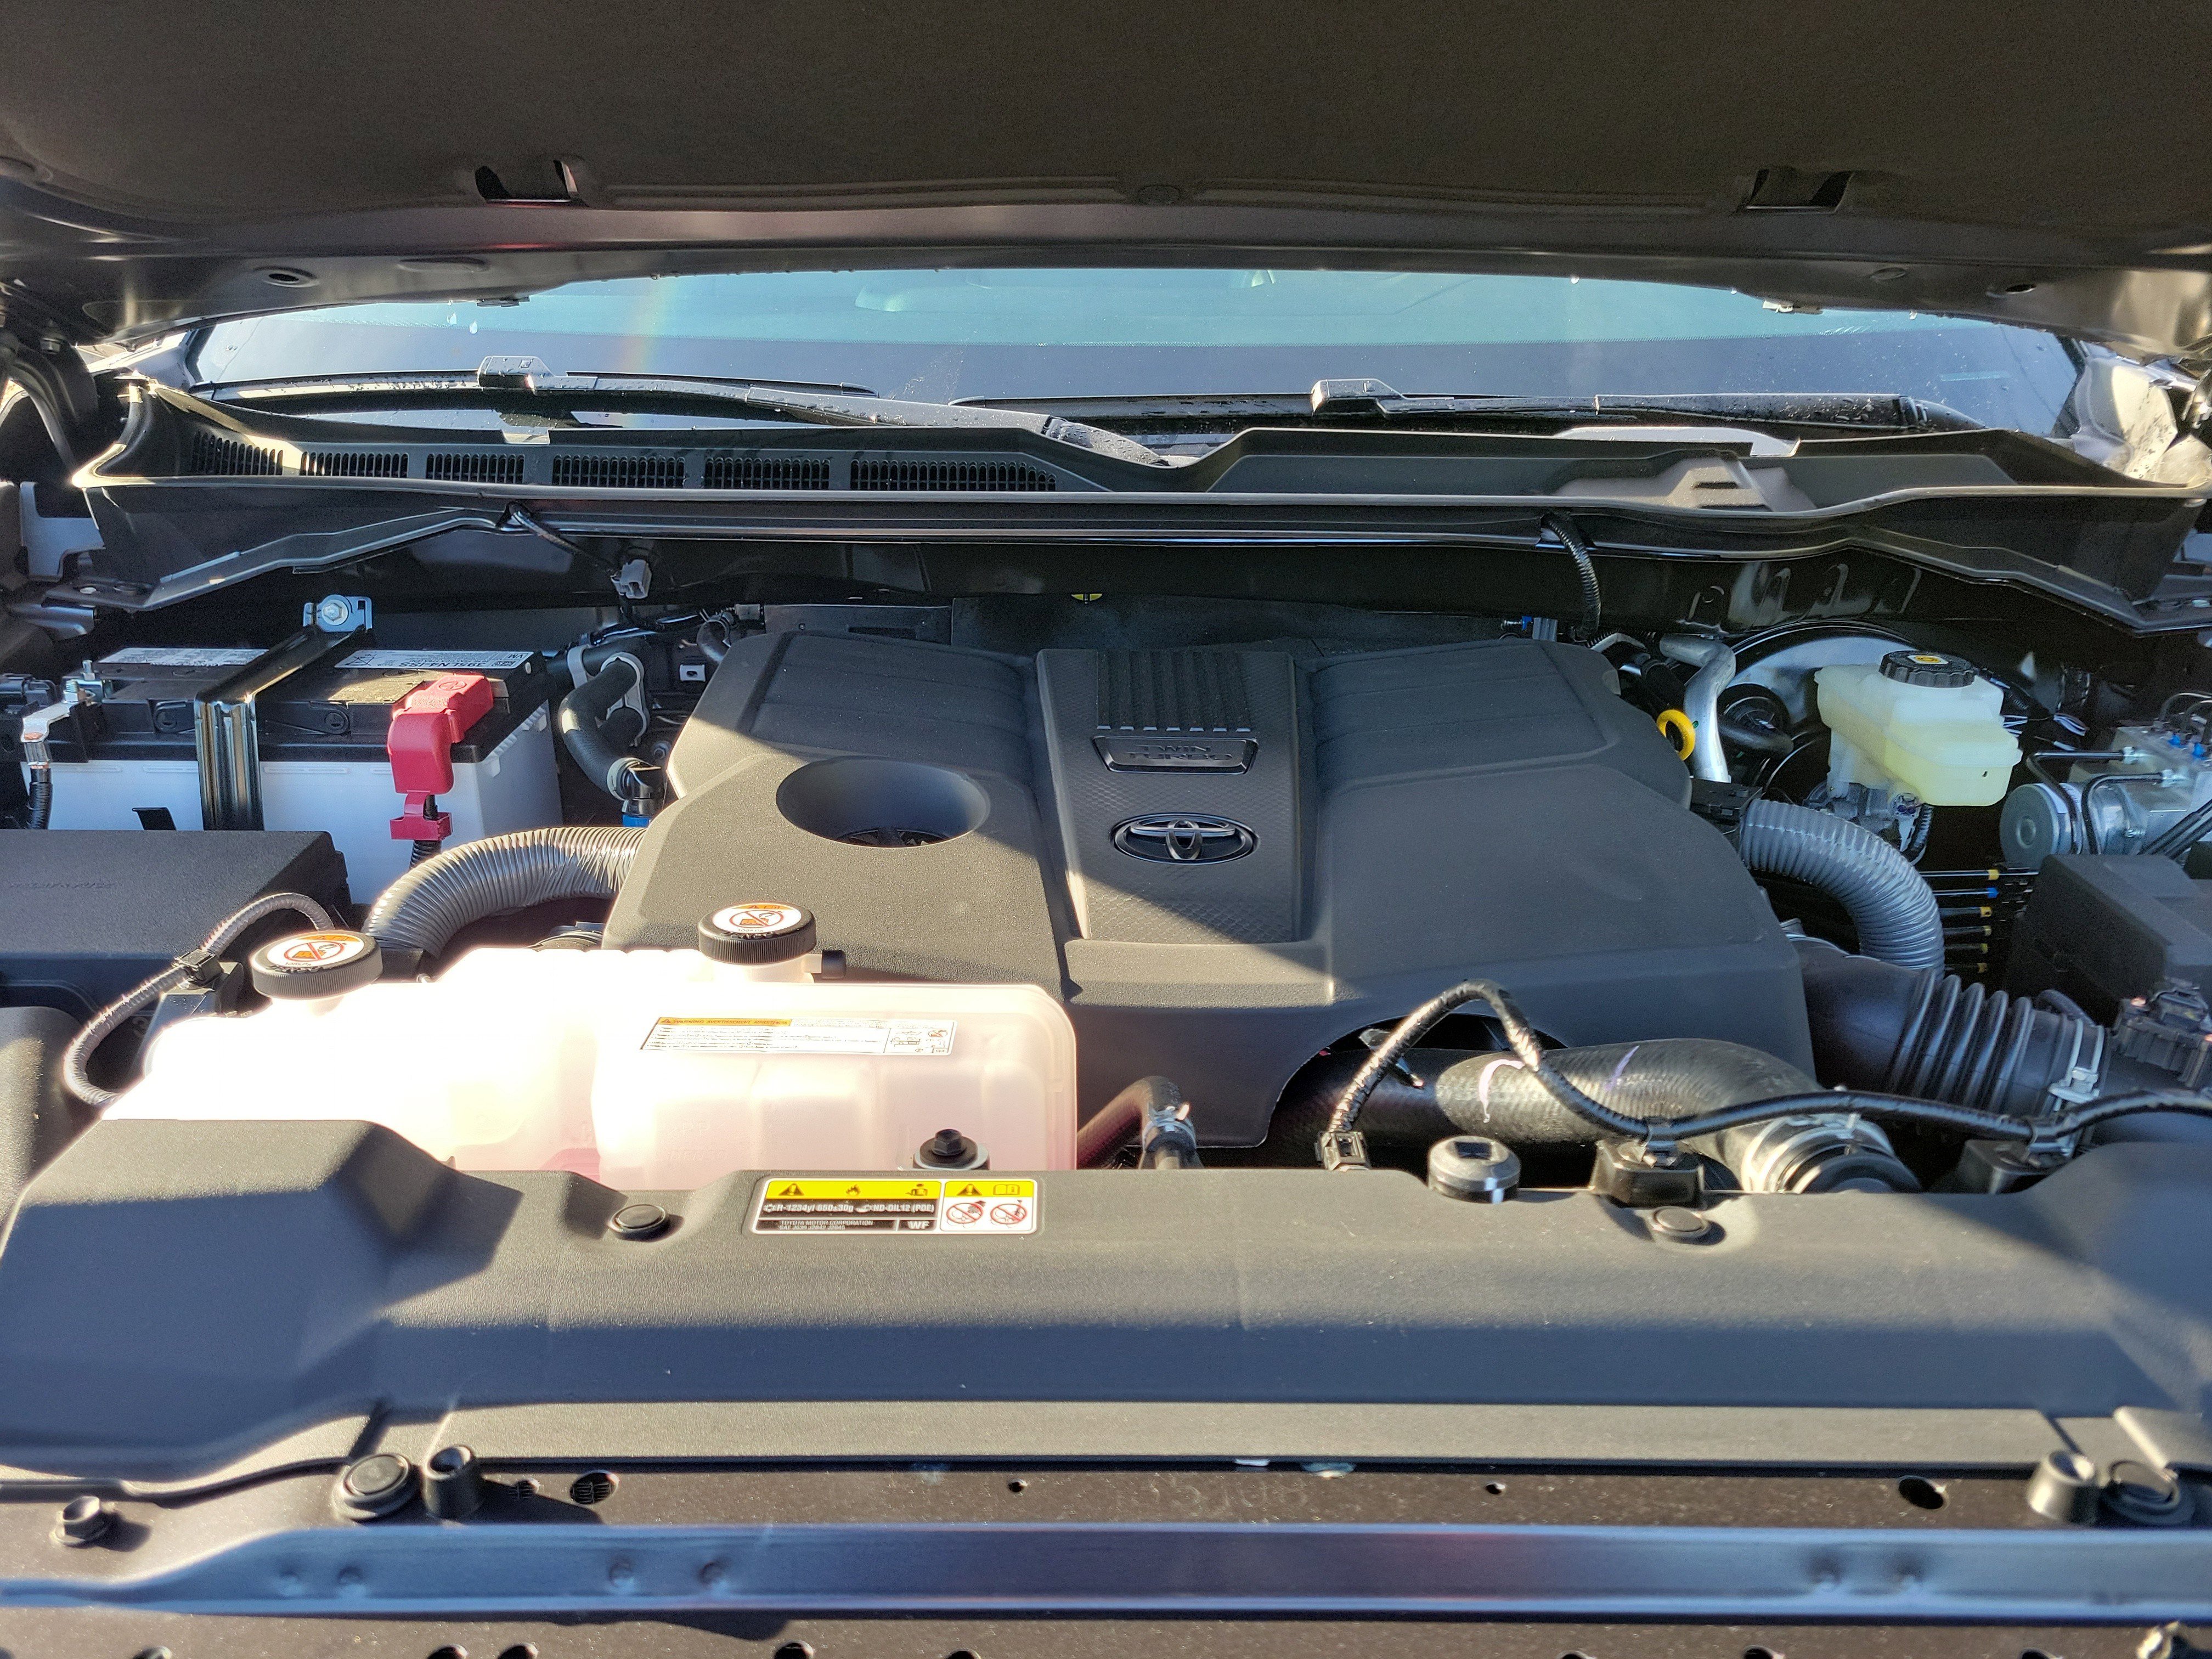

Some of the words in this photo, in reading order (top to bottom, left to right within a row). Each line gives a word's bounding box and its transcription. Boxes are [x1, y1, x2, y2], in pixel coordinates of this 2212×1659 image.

[1122, 752, 1233, 760] TURBO
[777, 1204, 815, 1212] R-1234yf
[911, 1204, 934, 1213] (POE)
[907, 1221, 930, 1229] WF
